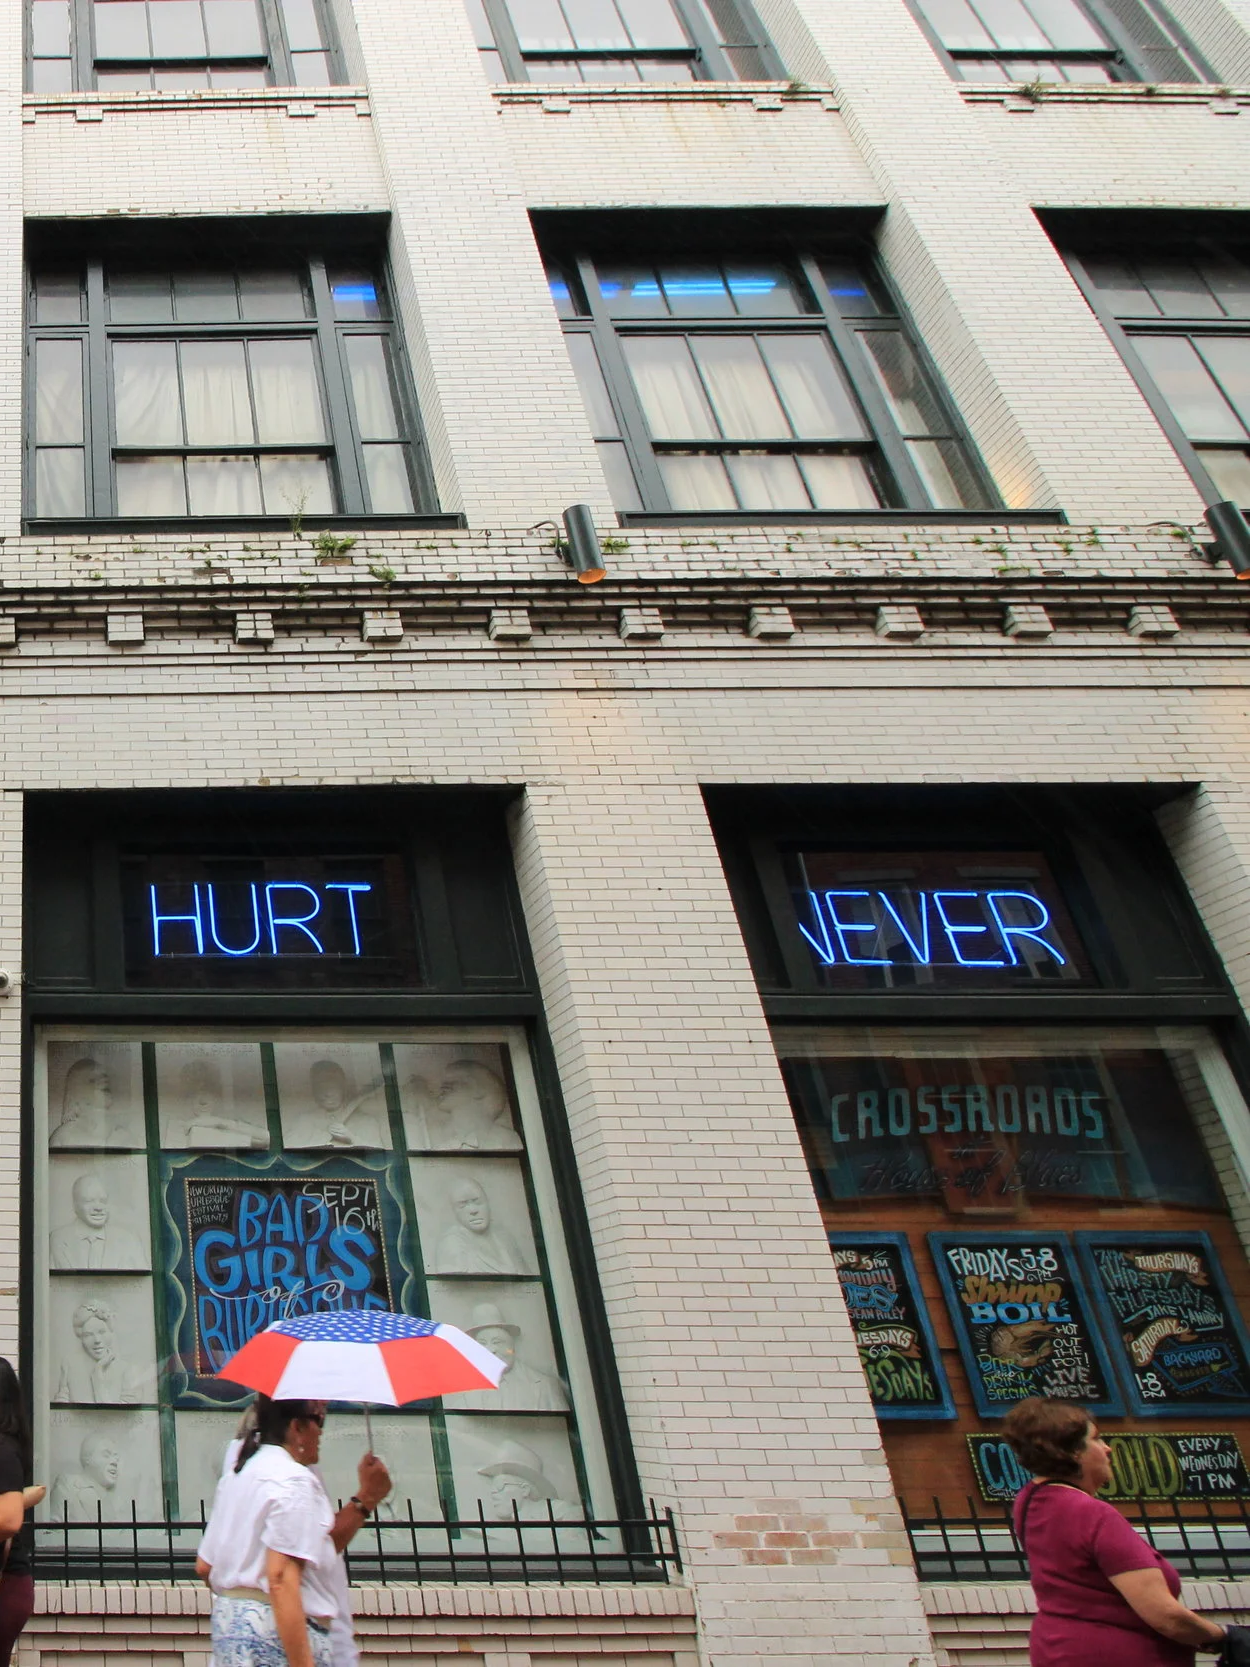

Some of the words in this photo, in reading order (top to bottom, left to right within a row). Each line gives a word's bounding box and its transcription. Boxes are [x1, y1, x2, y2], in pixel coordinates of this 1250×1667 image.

[150, 882, 372, 955] HURT
[831, 1084, 1104, 1143] CROSSROADS
[239, 1190, 330, 1248] BAD
[302, 1183, 375, 1214] SEPT
[335, 1207, 380, 1236] 16th
[194, 1226, 378, 1292] GIRLS
[947, 1247, 1024, 1282] FRIDAYS
[1135, 1252, 1199, 1274] THURSDAYS
[1036, 1270, 1052, 1283] PM
[1100, 1257, 1174, 1291] THIRSTY
[961, 1275, 1062, 1313] Shrimp
[876, 1307, 906, 1321] RILEY
[966, 1301, 1072, 1324] BOIL
[1146, 1303, 1179, 1320] JAKE
[1055, 1324, 1079, 1336] HOT
[1053, 1336, 1084, 1348] OUT
[1052, 1353, 1090, 1369] POT!
[1053, 1348, 1083, 1358] THE
[1163, 1347, 1223, 1368] BACKYARD
[976, 1354, 1025, 1373] BEER
[983, 1371, 1034, 1389] DRINK
[1045, 1367, 1090, 1386] LIVE
[987, 1385, 1041, 1401] SPECIALS
[1043, 1384, 1100, 1399] MUSIC
[1142, 1389, 1167, 1399] PM
[1177, 1437, 1221, 1453] EVERY
[1178, 1451, 1239, 1472] WEDNESDAY
[1188, 1475, 1203, 1491] 7
[1207, 1473, 1237, 1490] PM
